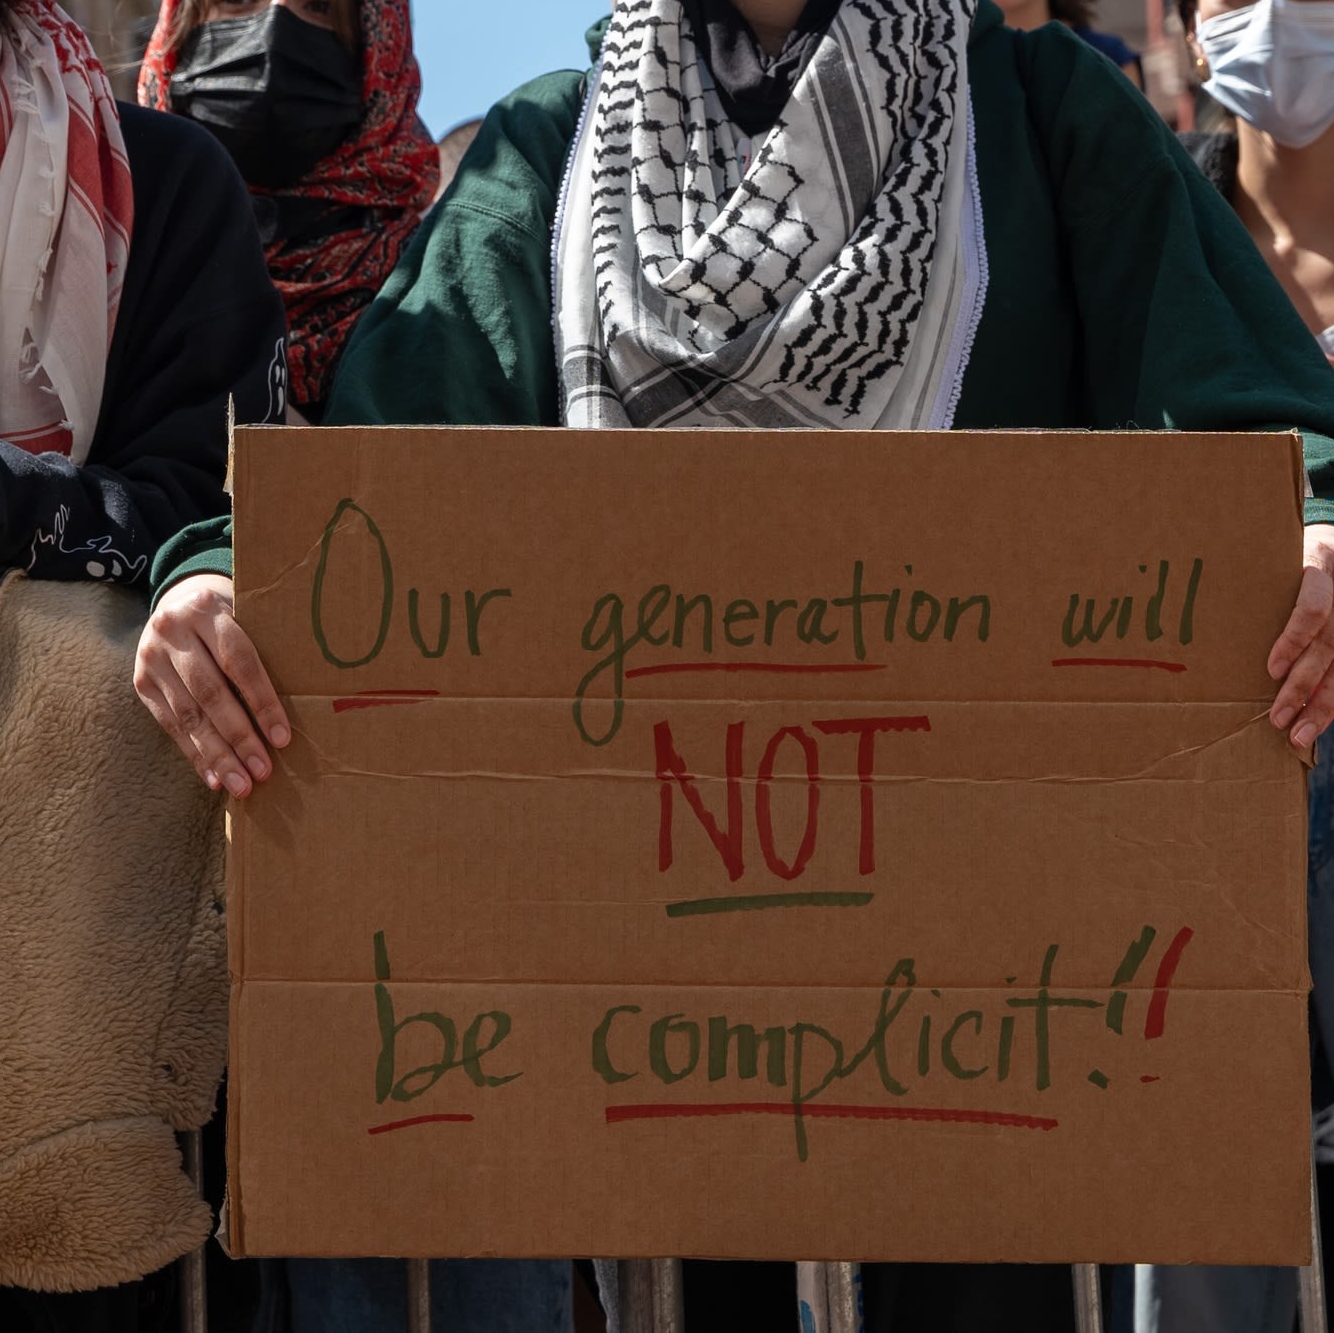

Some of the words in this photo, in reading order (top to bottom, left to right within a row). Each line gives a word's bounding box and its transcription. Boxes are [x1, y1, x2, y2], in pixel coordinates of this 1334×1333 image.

[310, 497, 512, 668] Our
[572, 560, 991, 745] generation
[1060, 557, 1203, 646] will
[652, 715, 932, 882] NOT
[373, 929, 524, 1103] be
